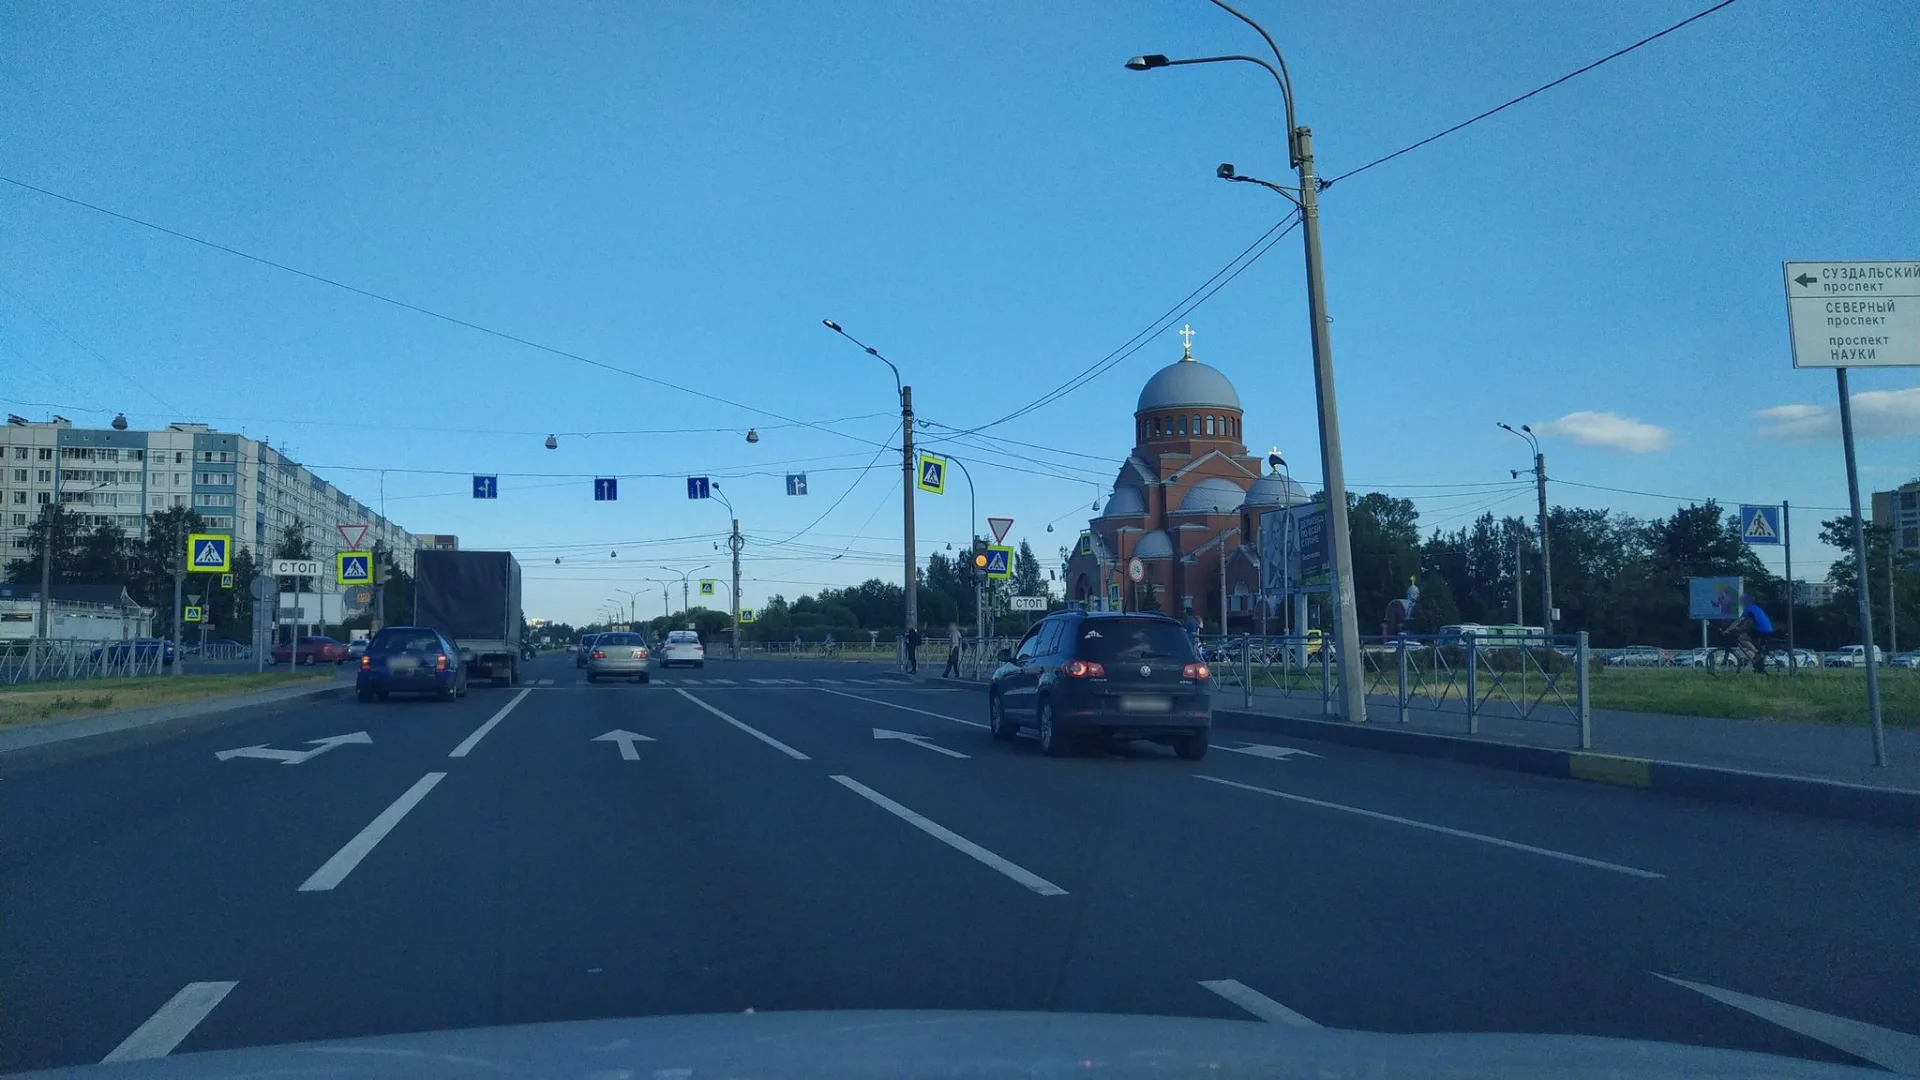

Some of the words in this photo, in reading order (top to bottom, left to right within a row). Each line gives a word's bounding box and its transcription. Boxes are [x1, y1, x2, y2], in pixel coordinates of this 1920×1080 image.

[1822, 265, 1920, 280] СУЗДАЛЬСКИЙ
[1823, 282, 1884, 294] проспект
[1825, 299, 1896, 313] СЕВЕРНЫЙ
[1827, 316, 1886, 328] проспект
[1829, 336, 1889, 348] проспект
[1831, 349, 1876, 360] НАУКИ
[279, 562, 317, 574] СТОП
[1016, 598, 1043, 609] СТОП
